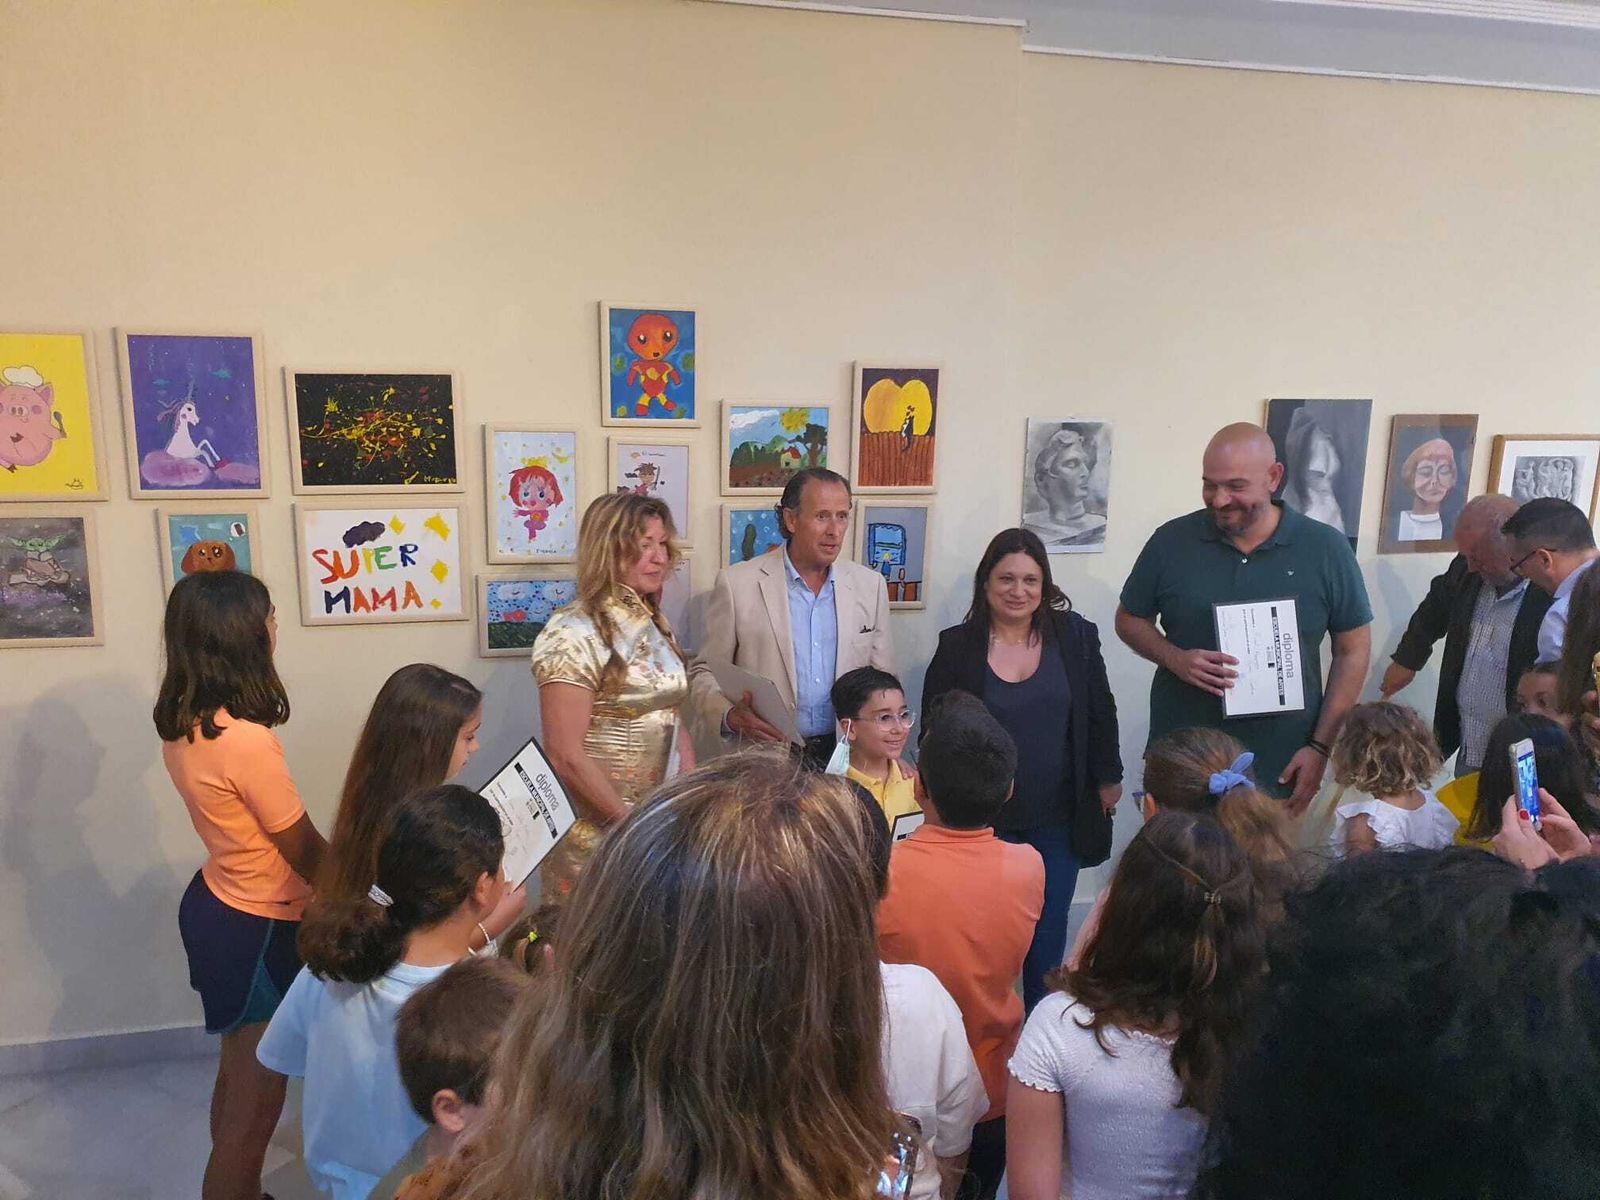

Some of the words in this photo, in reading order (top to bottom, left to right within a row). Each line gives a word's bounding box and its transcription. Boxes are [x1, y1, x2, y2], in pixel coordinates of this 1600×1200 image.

[312, 543, 418, 584] SUPER
[324, 580, 423, 614] MAMA
[1272, 617, 1280, 641] ESCUELA
[1274, 641, 1282, 668] MUNICIPAL
[1282, 632, 1294, 678] diploma
[519, 770, 534, 791] ESCUELA
[531, 788, 547, 813] MUNICIPAL
[536, 773, 559, 811] diploma
